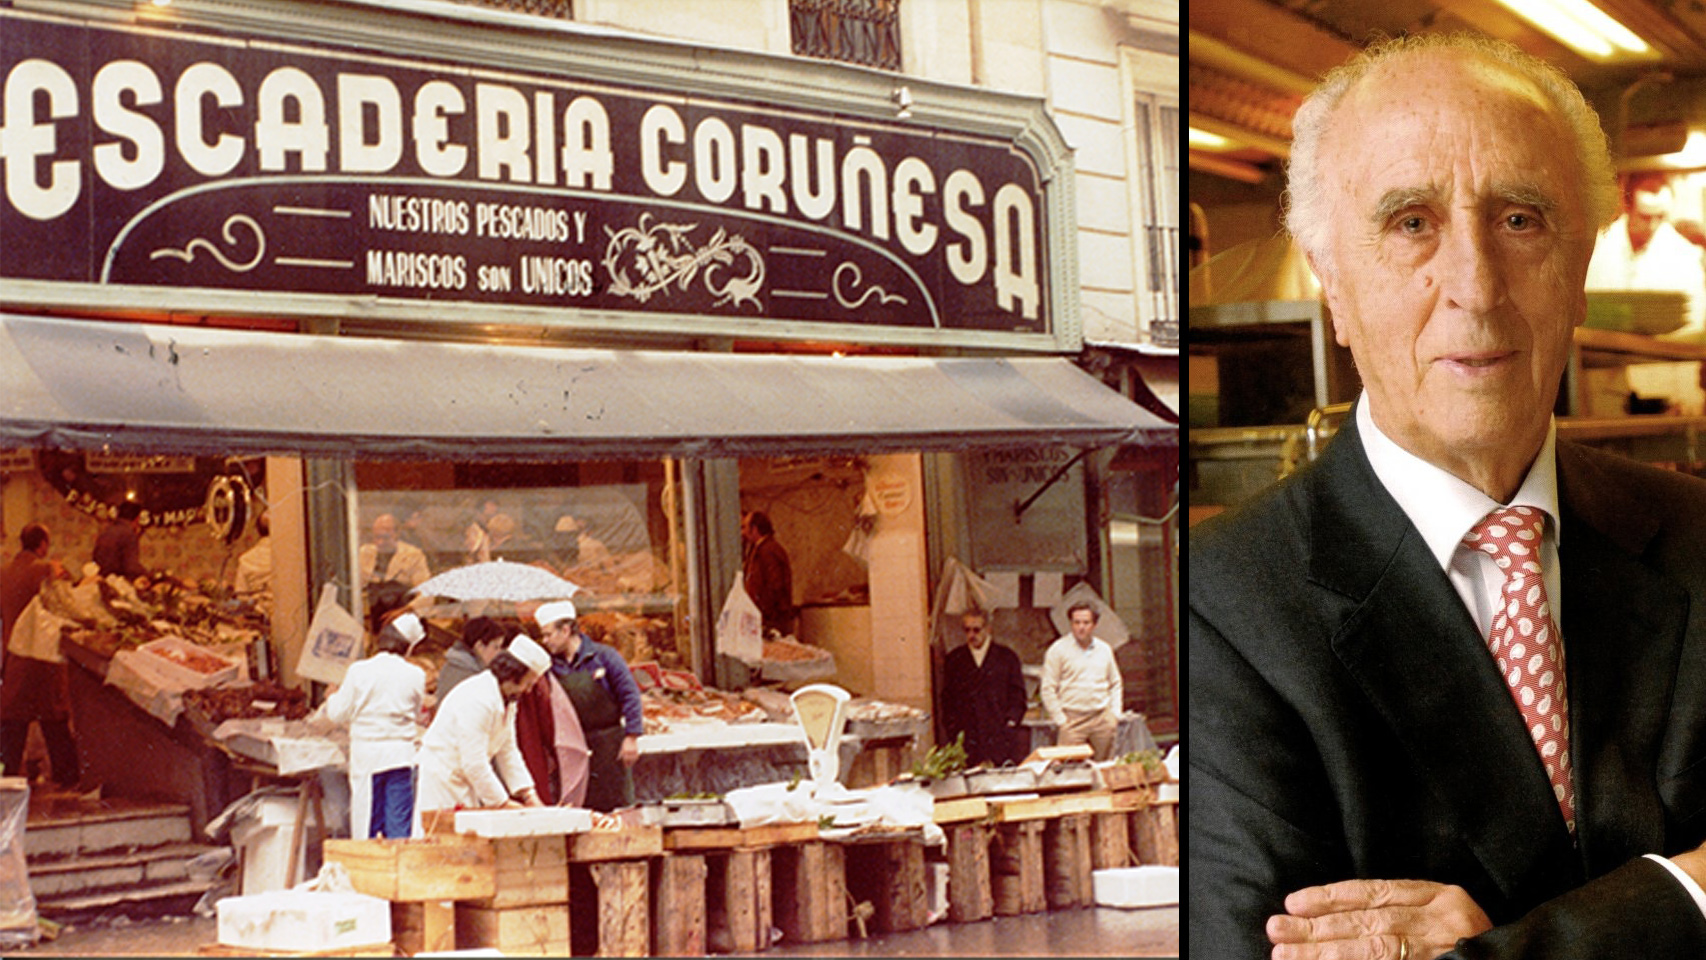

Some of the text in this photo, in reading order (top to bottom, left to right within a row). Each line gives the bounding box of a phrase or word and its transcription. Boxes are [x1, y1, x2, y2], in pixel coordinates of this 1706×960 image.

[369, 194, 587, 244] NUESTROS PESCADOS Y
[639, 104, 1040, 320] CORUÑESA
[367, 250, 593, 296] MARISCOS SON UNICOS
